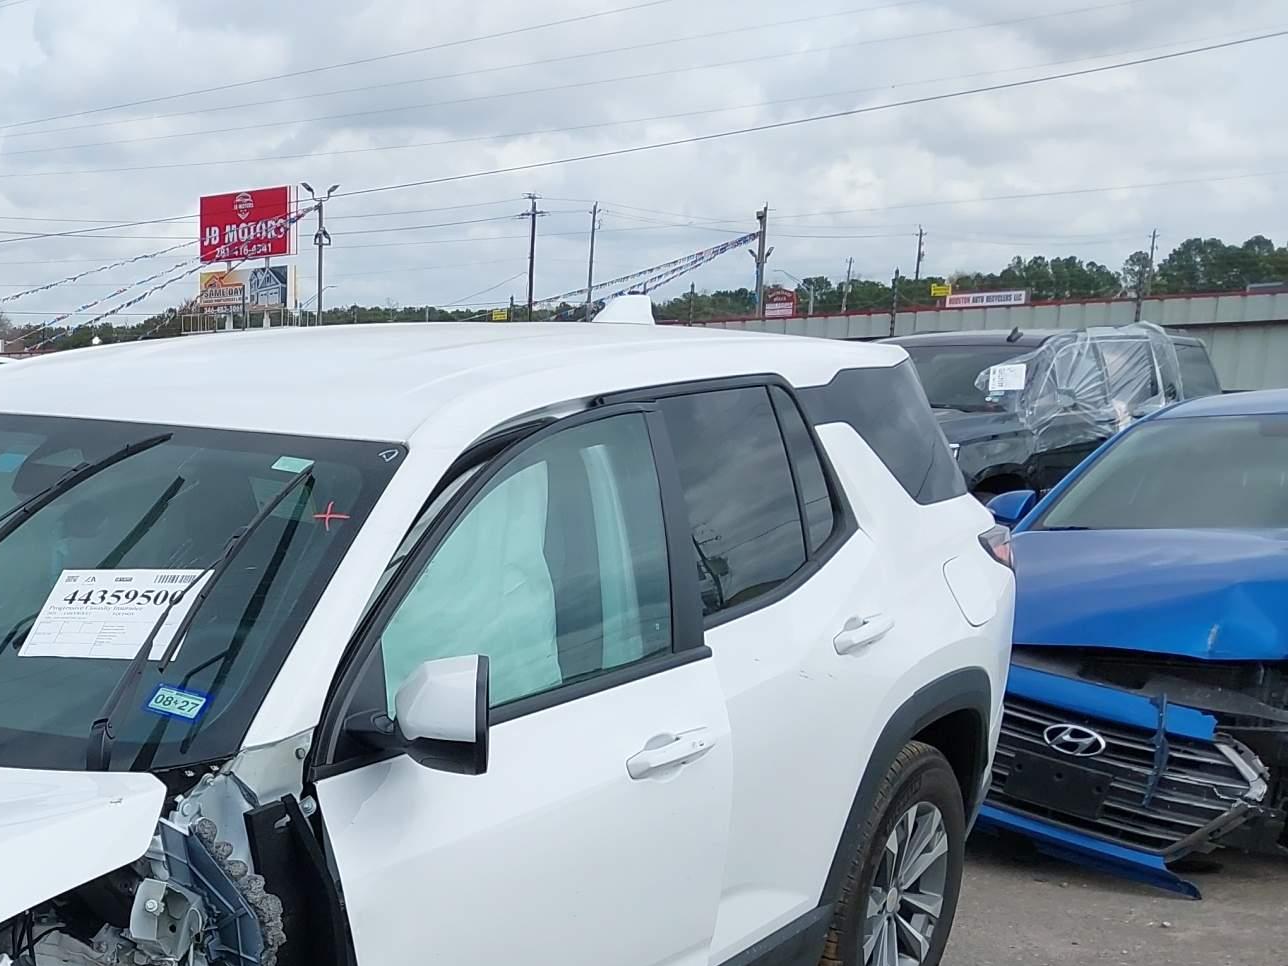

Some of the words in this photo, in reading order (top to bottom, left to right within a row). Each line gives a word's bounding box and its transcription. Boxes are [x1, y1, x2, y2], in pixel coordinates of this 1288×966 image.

[203, 226, 220, 246] JB
[224, 218, 285, 244] MOTORS
[228, 287, 243, 297] DAY
[63, 588, 185, 606] 44359500
